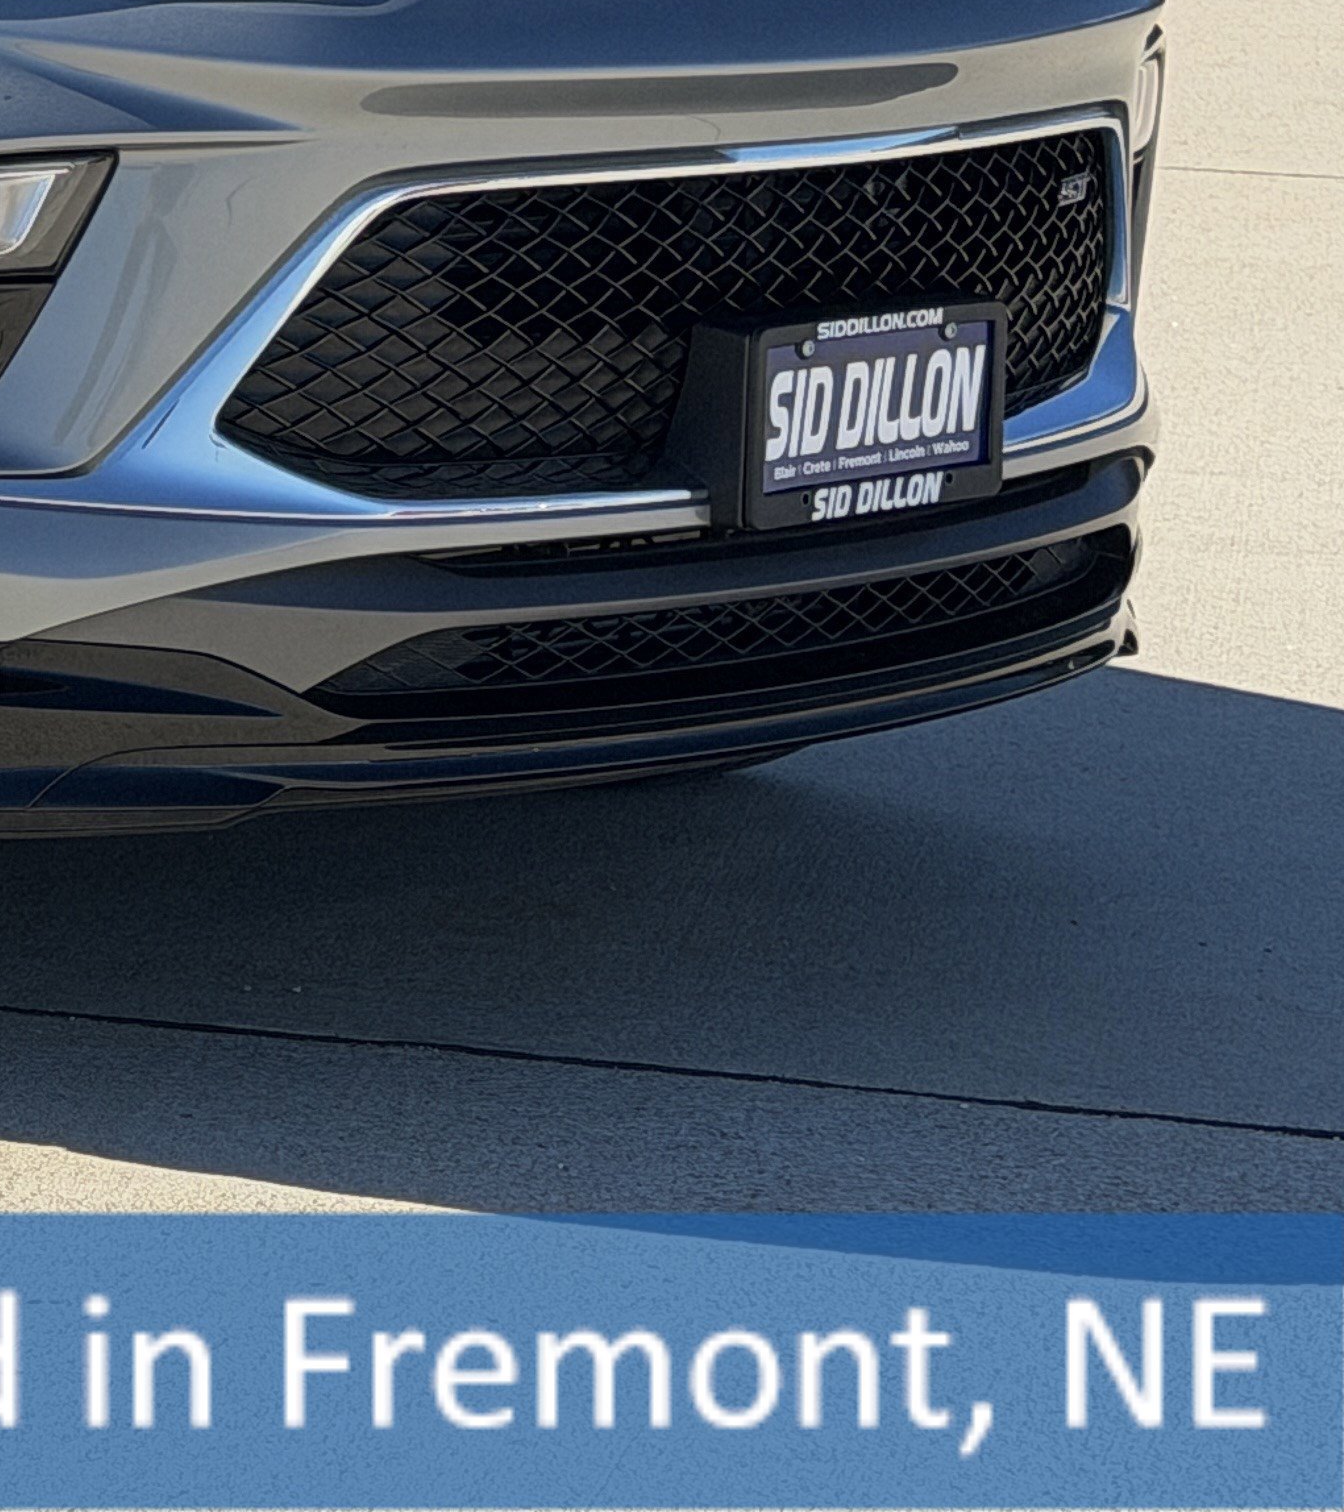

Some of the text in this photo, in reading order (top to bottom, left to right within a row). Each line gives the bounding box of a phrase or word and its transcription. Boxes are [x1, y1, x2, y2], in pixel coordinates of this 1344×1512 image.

[817, 307, 944, 340] SIDDILLON.COM
[765, 345, 986, 462] SID DILLON
[838, 452, 882, 470] Fremont
[888, 446, 926, 462] Lincoln
[932, 440, 970, 456] Wahoo
[811, 471, 944, 522] SID DILLON
